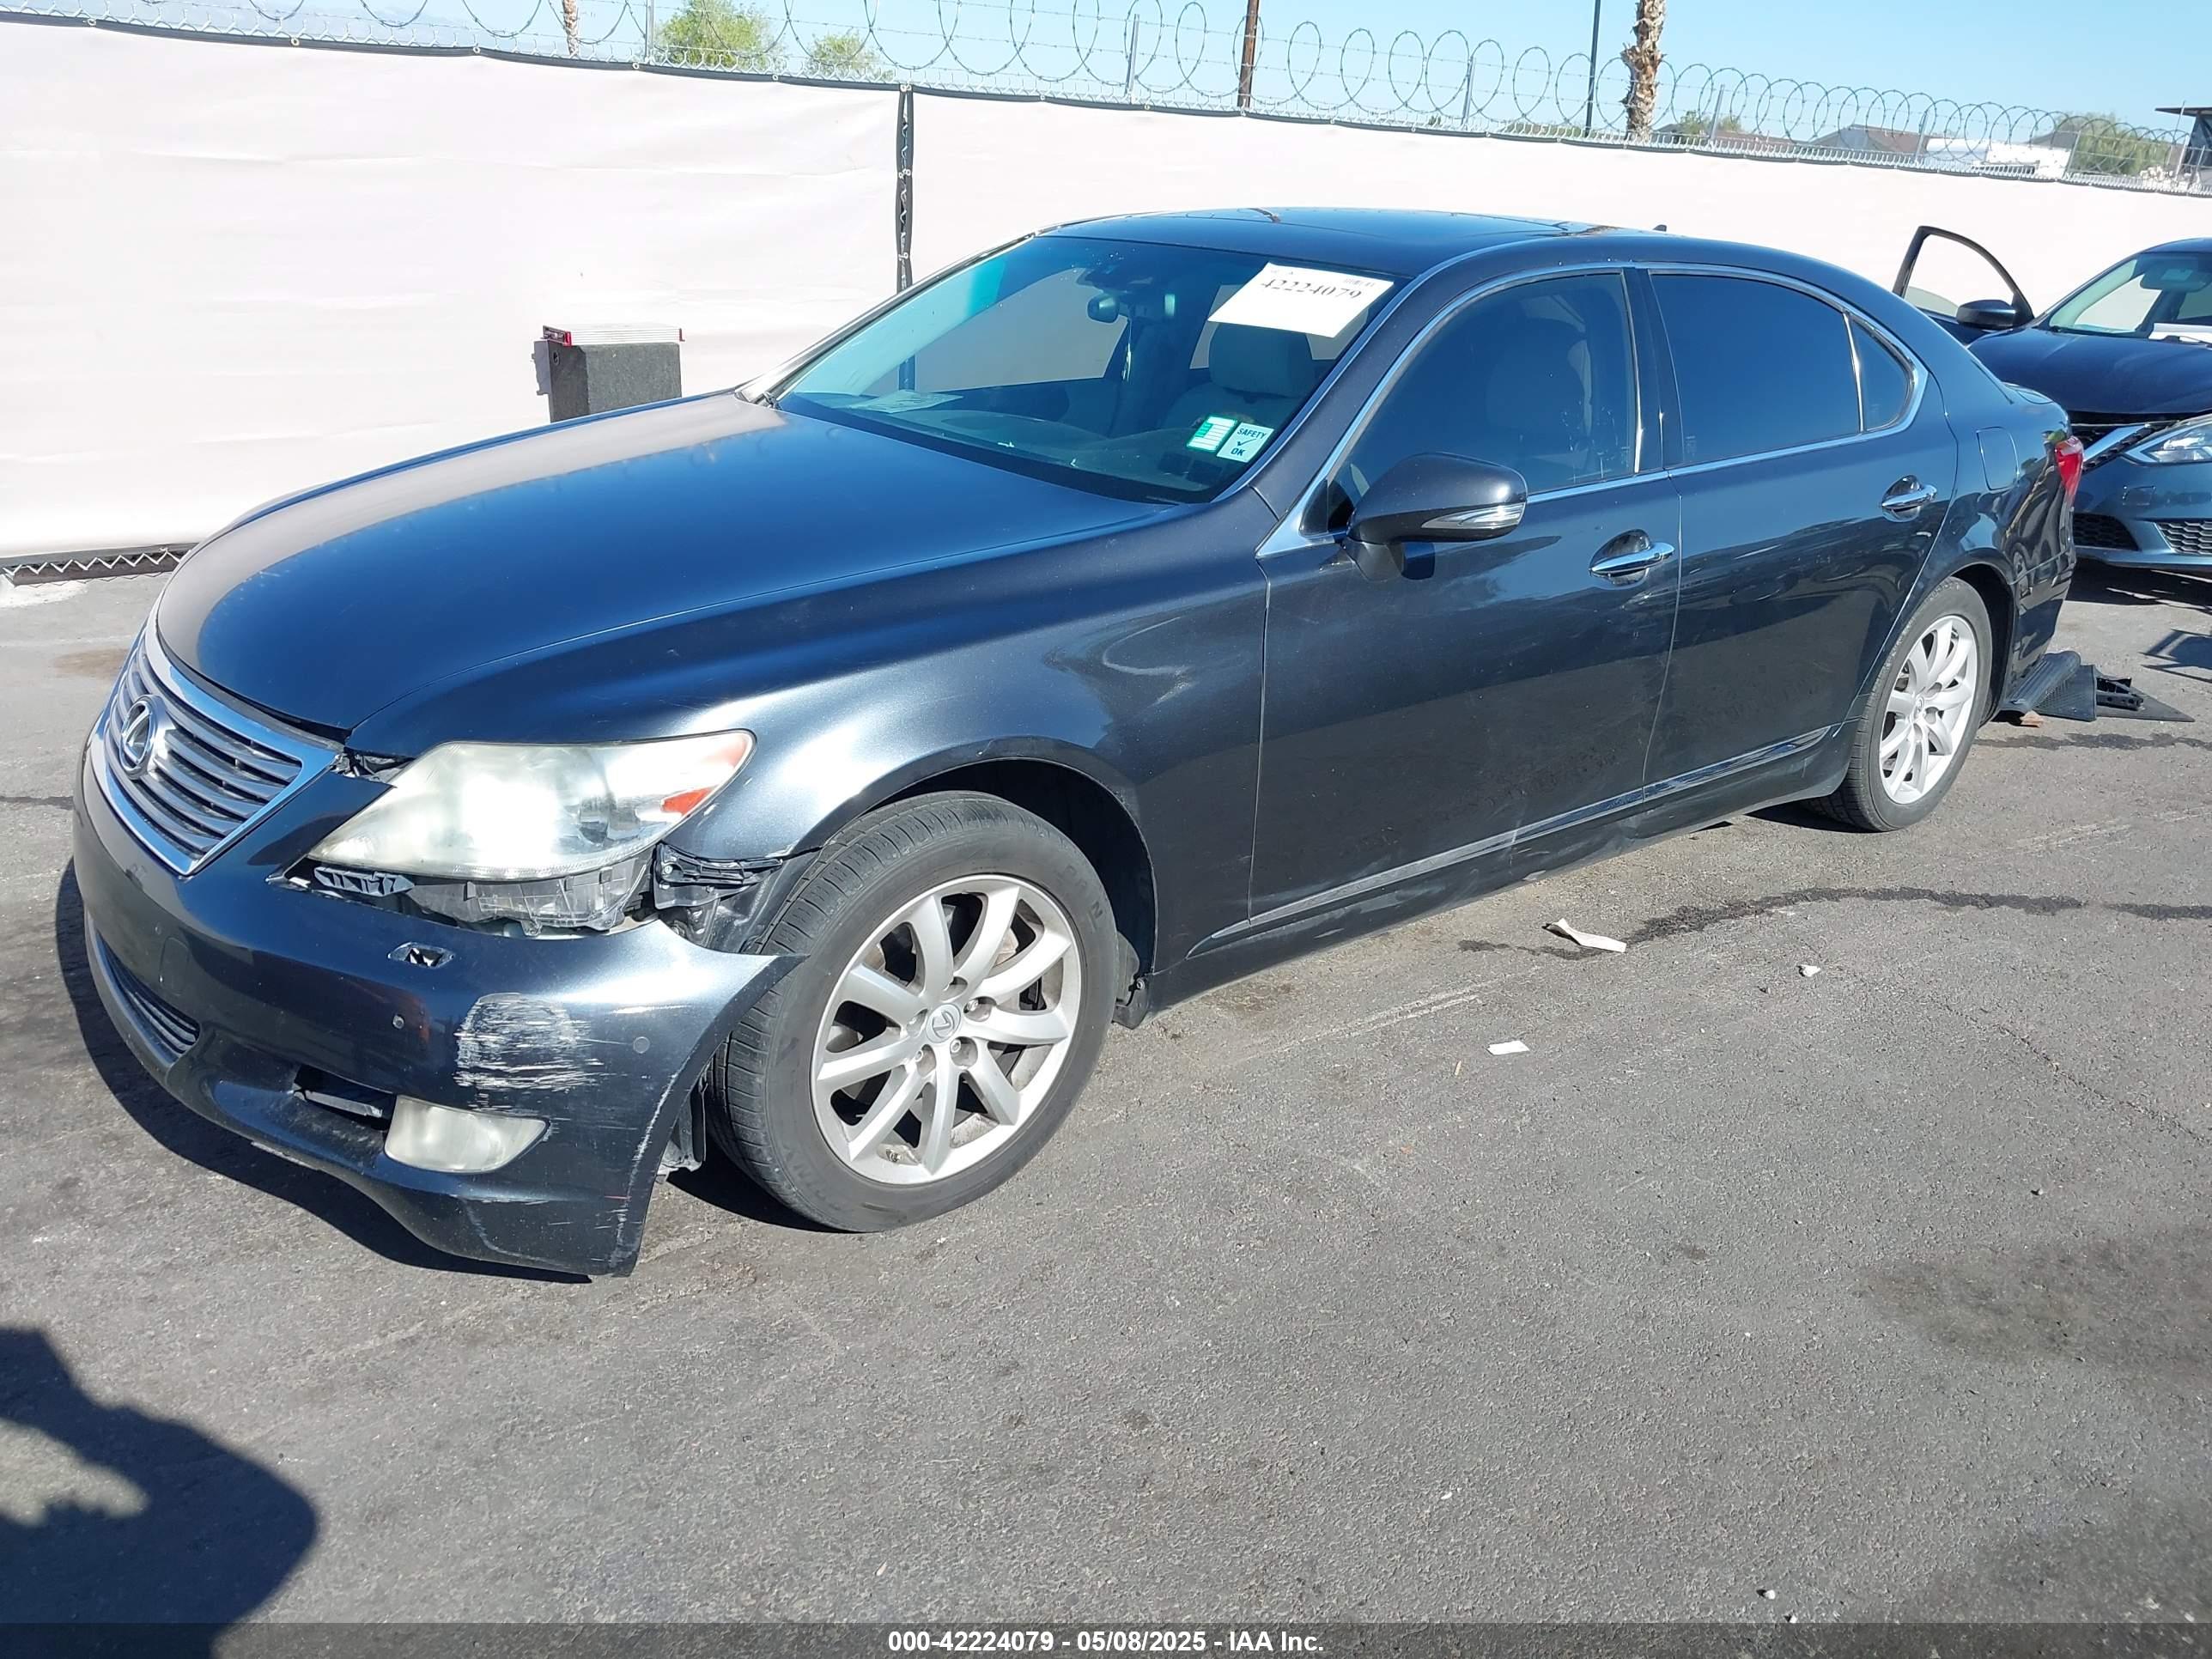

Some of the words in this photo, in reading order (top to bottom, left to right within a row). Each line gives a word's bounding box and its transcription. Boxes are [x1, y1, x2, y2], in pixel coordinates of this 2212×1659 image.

[1261, 277, 1363, 300] 42224079
[1237, 428, 1267, 440] SAFETY
[1231, 447, 1246, 456] OK
